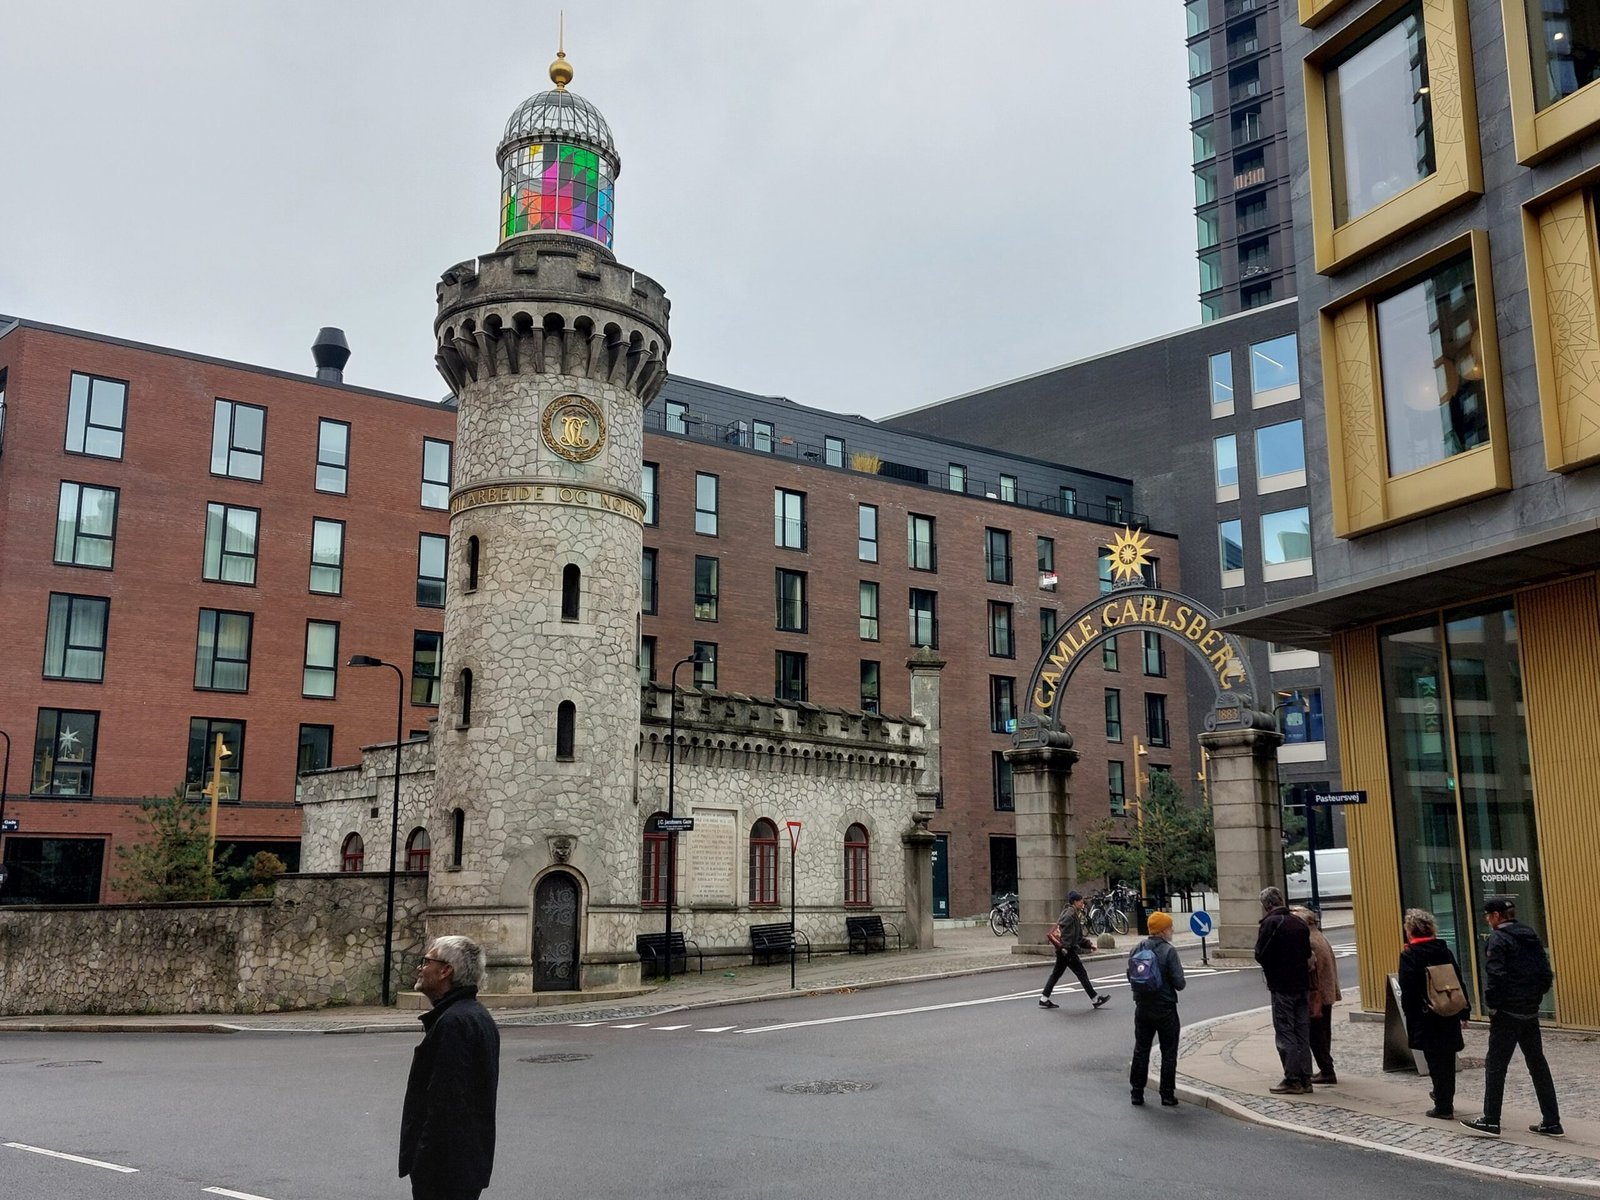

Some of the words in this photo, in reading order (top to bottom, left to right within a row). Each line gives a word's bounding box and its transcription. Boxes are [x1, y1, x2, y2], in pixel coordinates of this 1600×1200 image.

[1033, 614, 1099, 709] GAMLE
[1102, 596, 1246, 690] CARLSBERG
[1315, 792, 1360, 803] Pasteursvej
[1480, 857, 1530, 873] MUUN
[1481, 873, 1530, 882] COPENHAGEN
